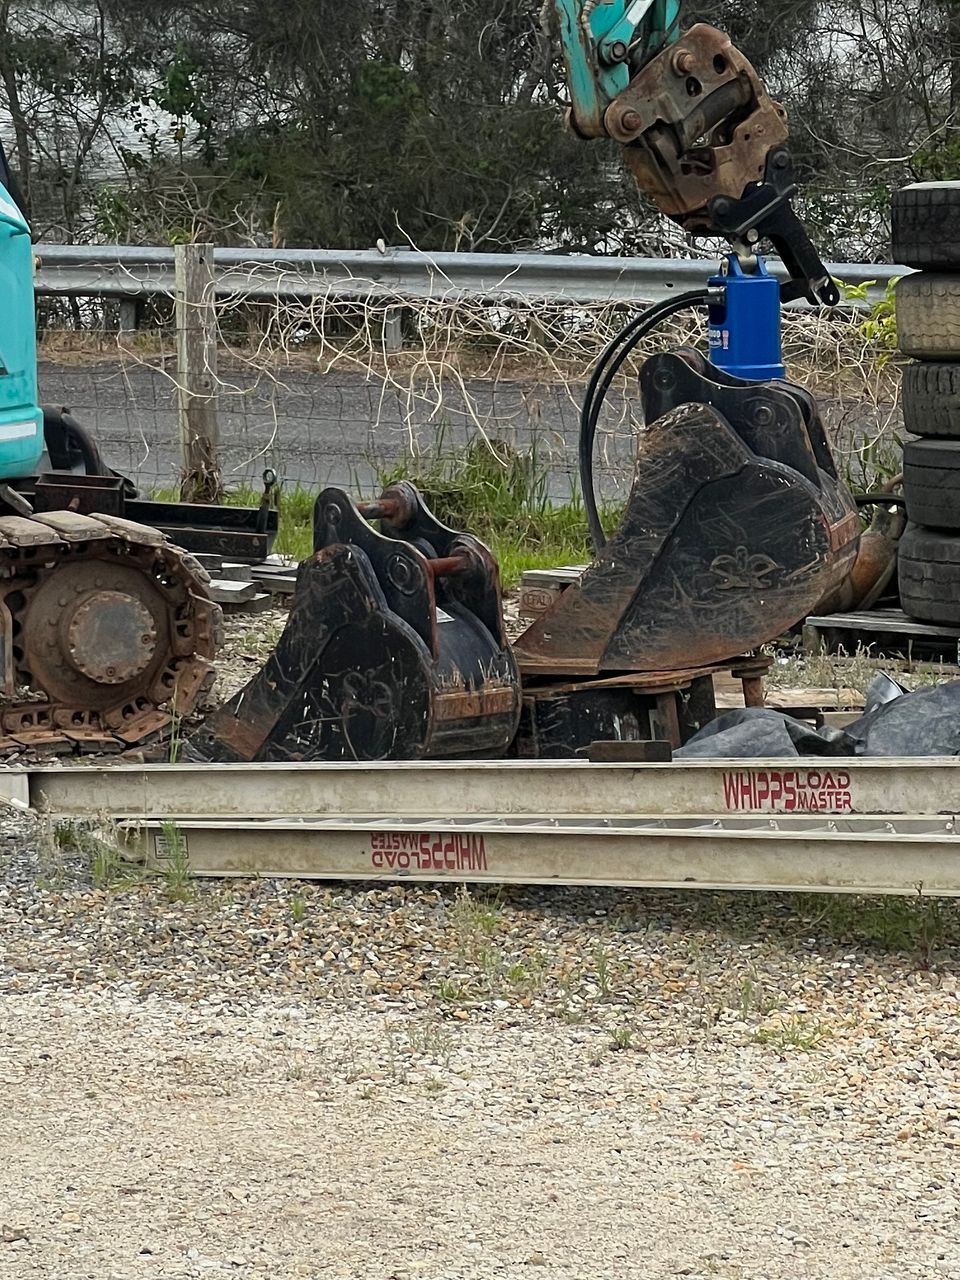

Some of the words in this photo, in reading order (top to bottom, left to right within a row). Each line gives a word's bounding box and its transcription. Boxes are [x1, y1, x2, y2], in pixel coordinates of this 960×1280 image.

[723, 772, 797, 810] WHIPPS
[796, 772, 850, 789] LOAD
[797, 791, 852, 811] MASTER
[370, 832, 419, 850] MASTER
[372, 851, 420, 868] LOAD
